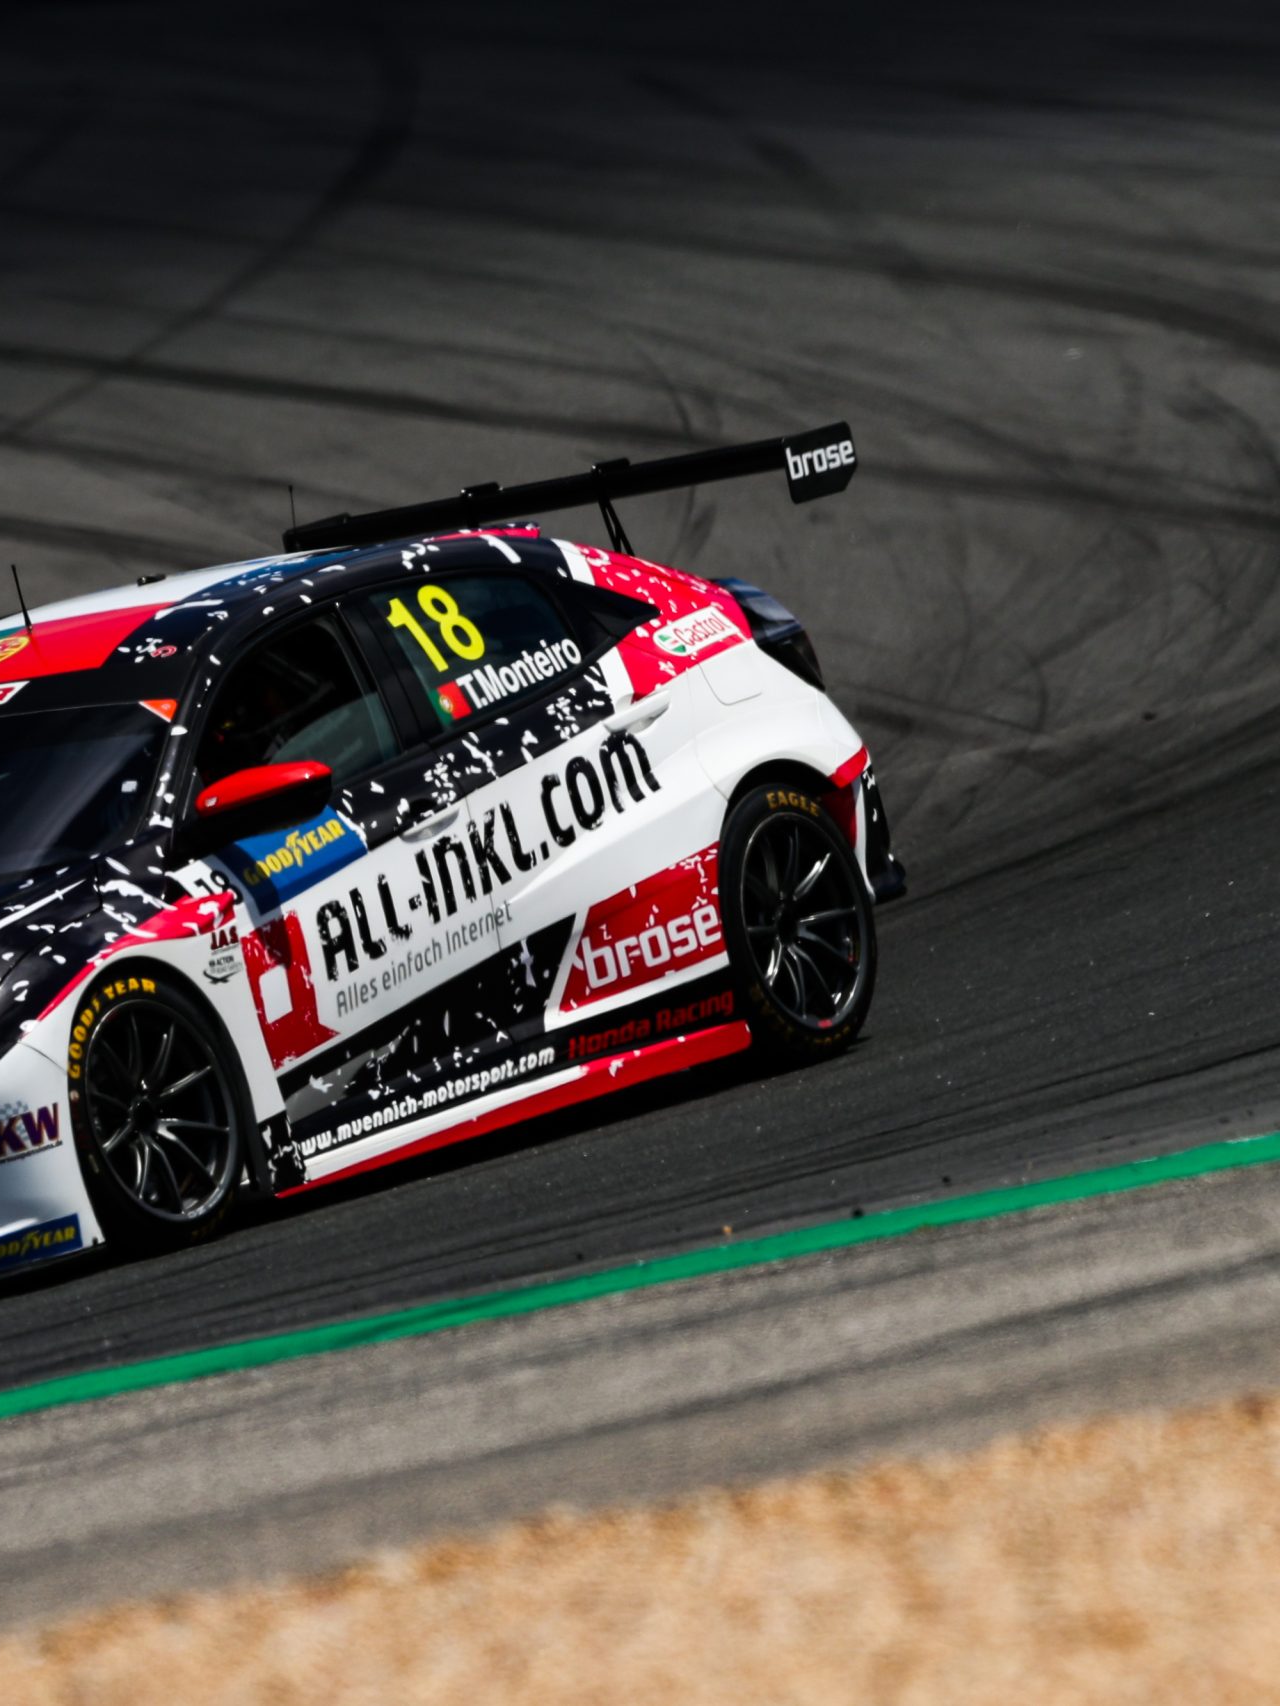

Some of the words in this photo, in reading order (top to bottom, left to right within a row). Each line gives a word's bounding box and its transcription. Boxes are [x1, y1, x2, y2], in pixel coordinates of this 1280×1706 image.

[785, 439, 855, 481] brose
[387, 584, 485, 673] 18
[673, 611, 730, 647] Castrol
[455, 637, 582, 710] T.Monteiro
[766, 789, 821, 817] EAGLE
[336, 983, 379, 1018] Alles
[382, 938, 443, 992] einfach
[445, 902, 514, 955] Internet
[581, 903, 722, 989] brose
[568, 1017, 652, 1060] Honda
[655, 990, 735, 1034] Racing
[298, 1046, 555, 1156] ww.muennich-motorsport.com
